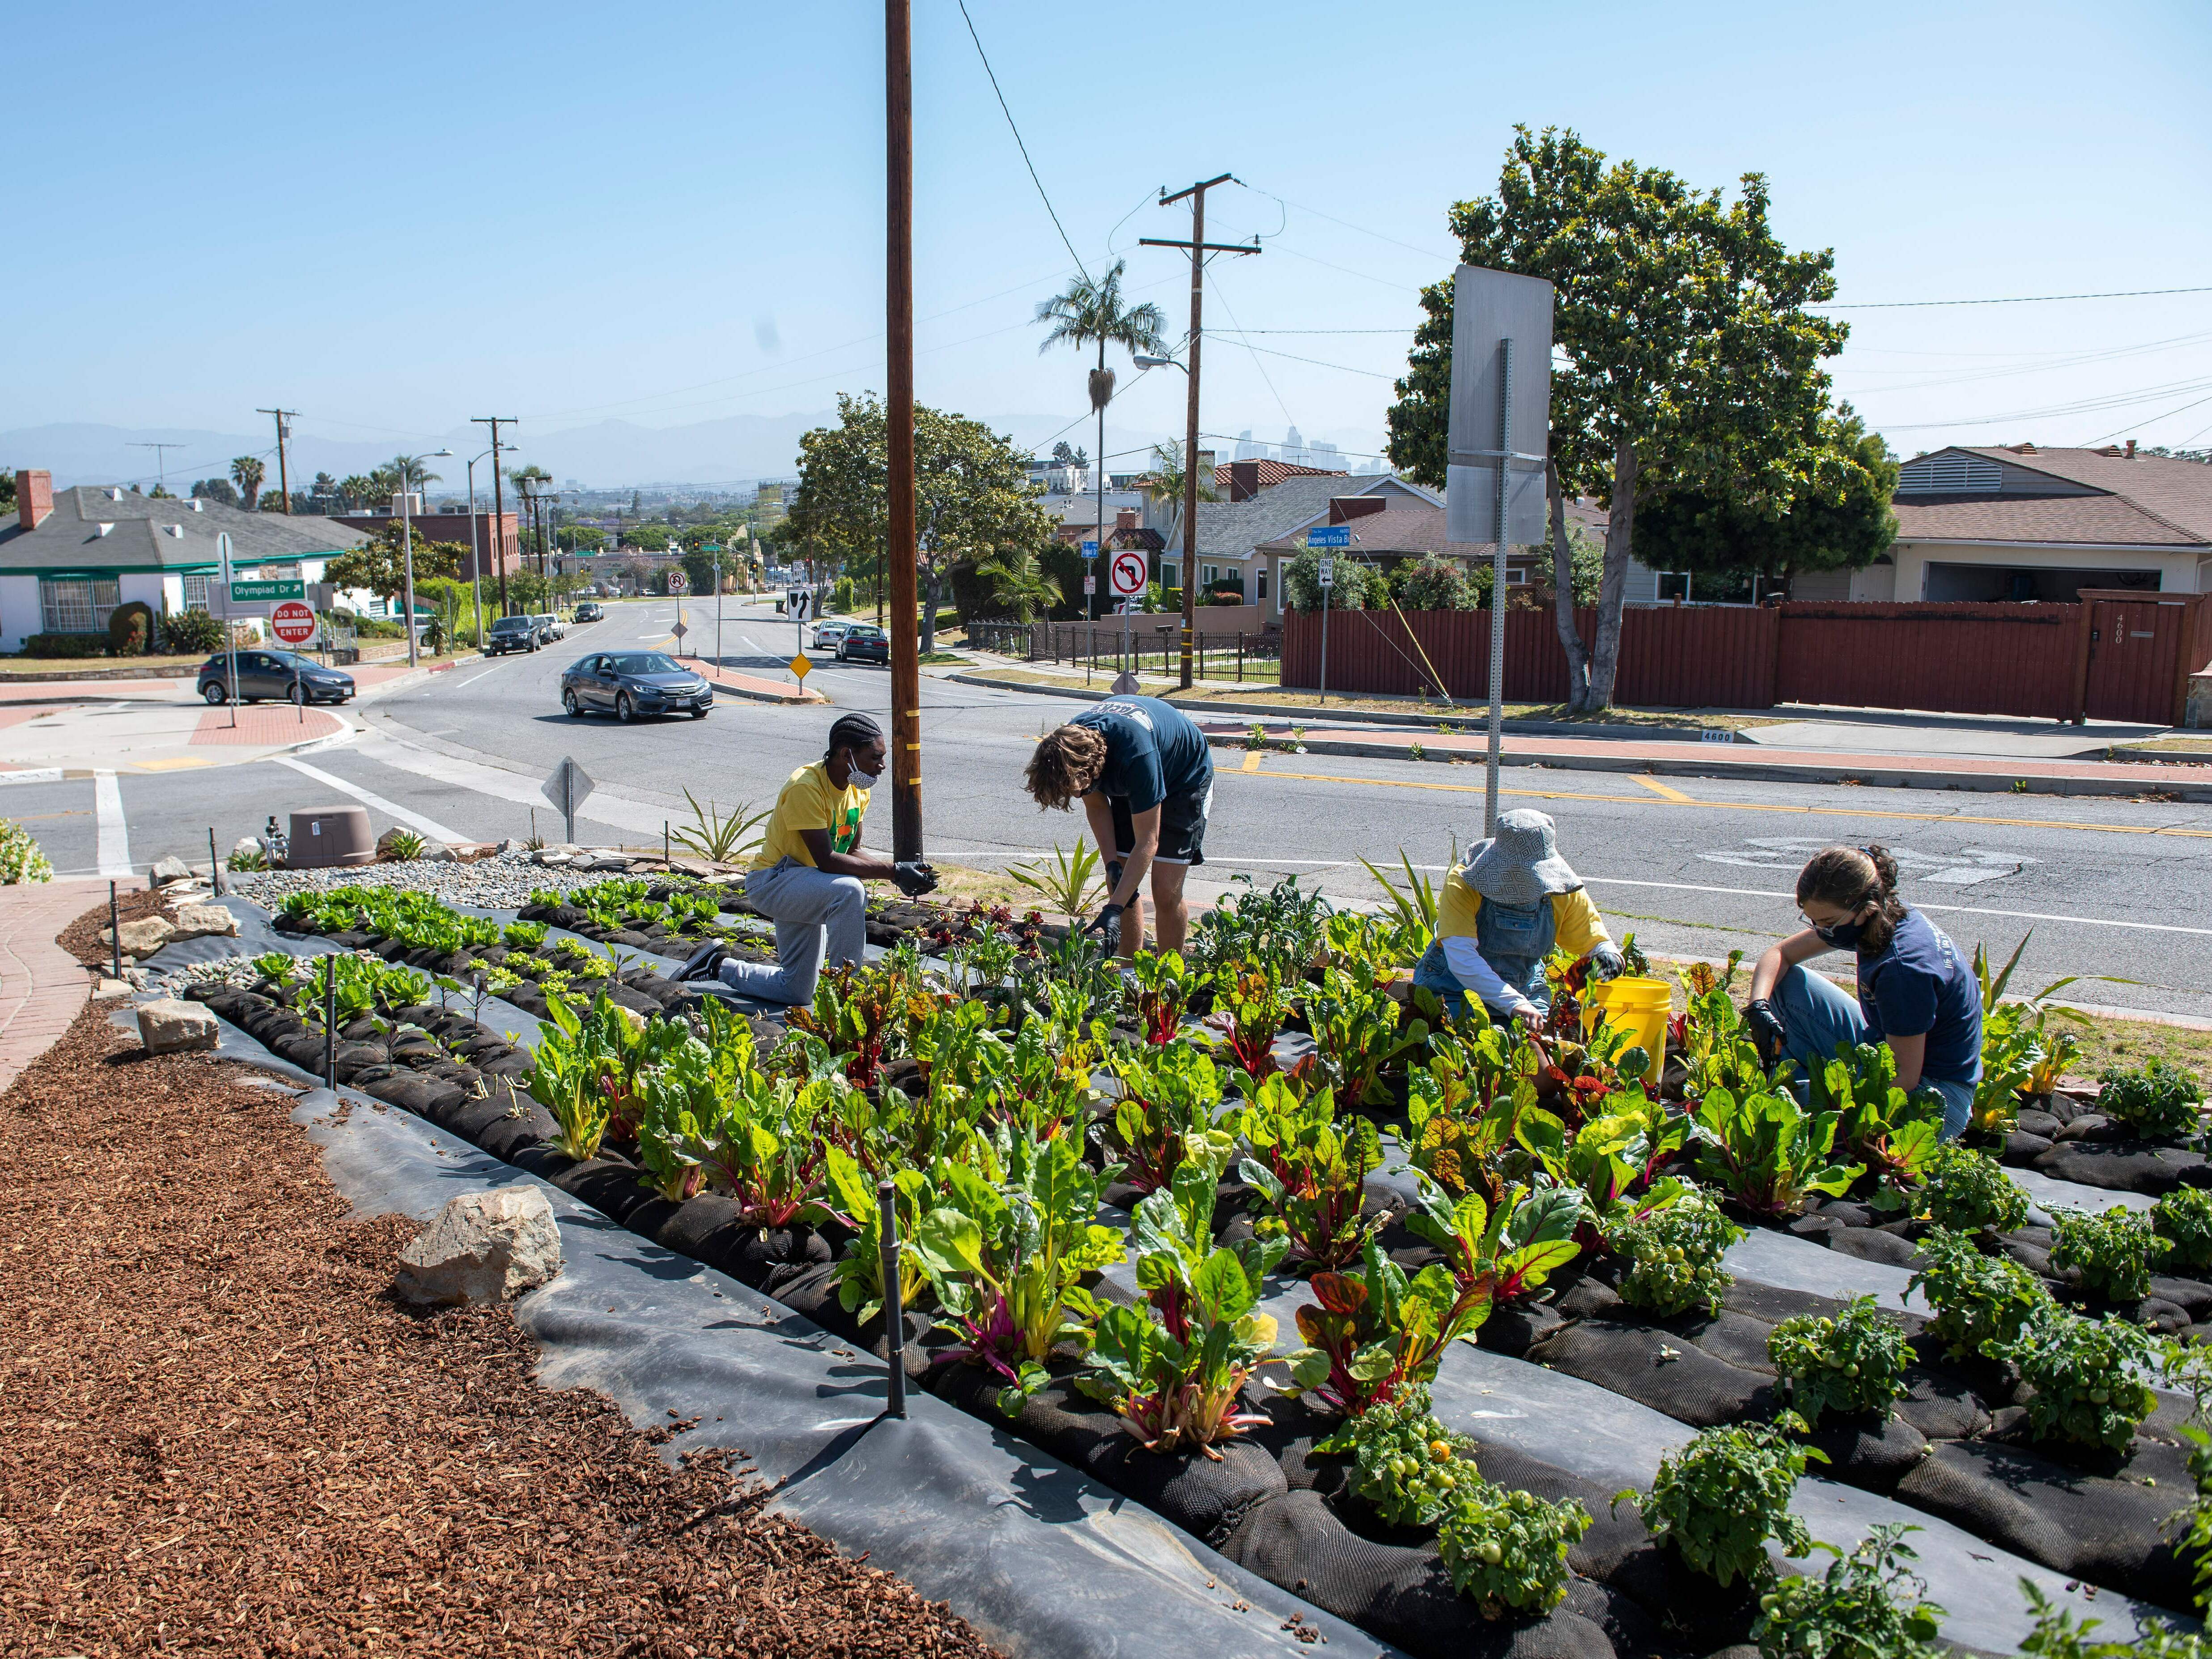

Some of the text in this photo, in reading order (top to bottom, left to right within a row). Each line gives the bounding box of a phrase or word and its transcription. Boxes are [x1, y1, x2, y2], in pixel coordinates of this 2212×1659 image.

[1308, 536, 1326, 545] Angeles
[1328, 535, 1342, 544] Vista
[234, 585, 290, 596] Olympiad Dr
[280, 628, 309, 636] ENTER
[1705, 732, 1730, 741] 4600
